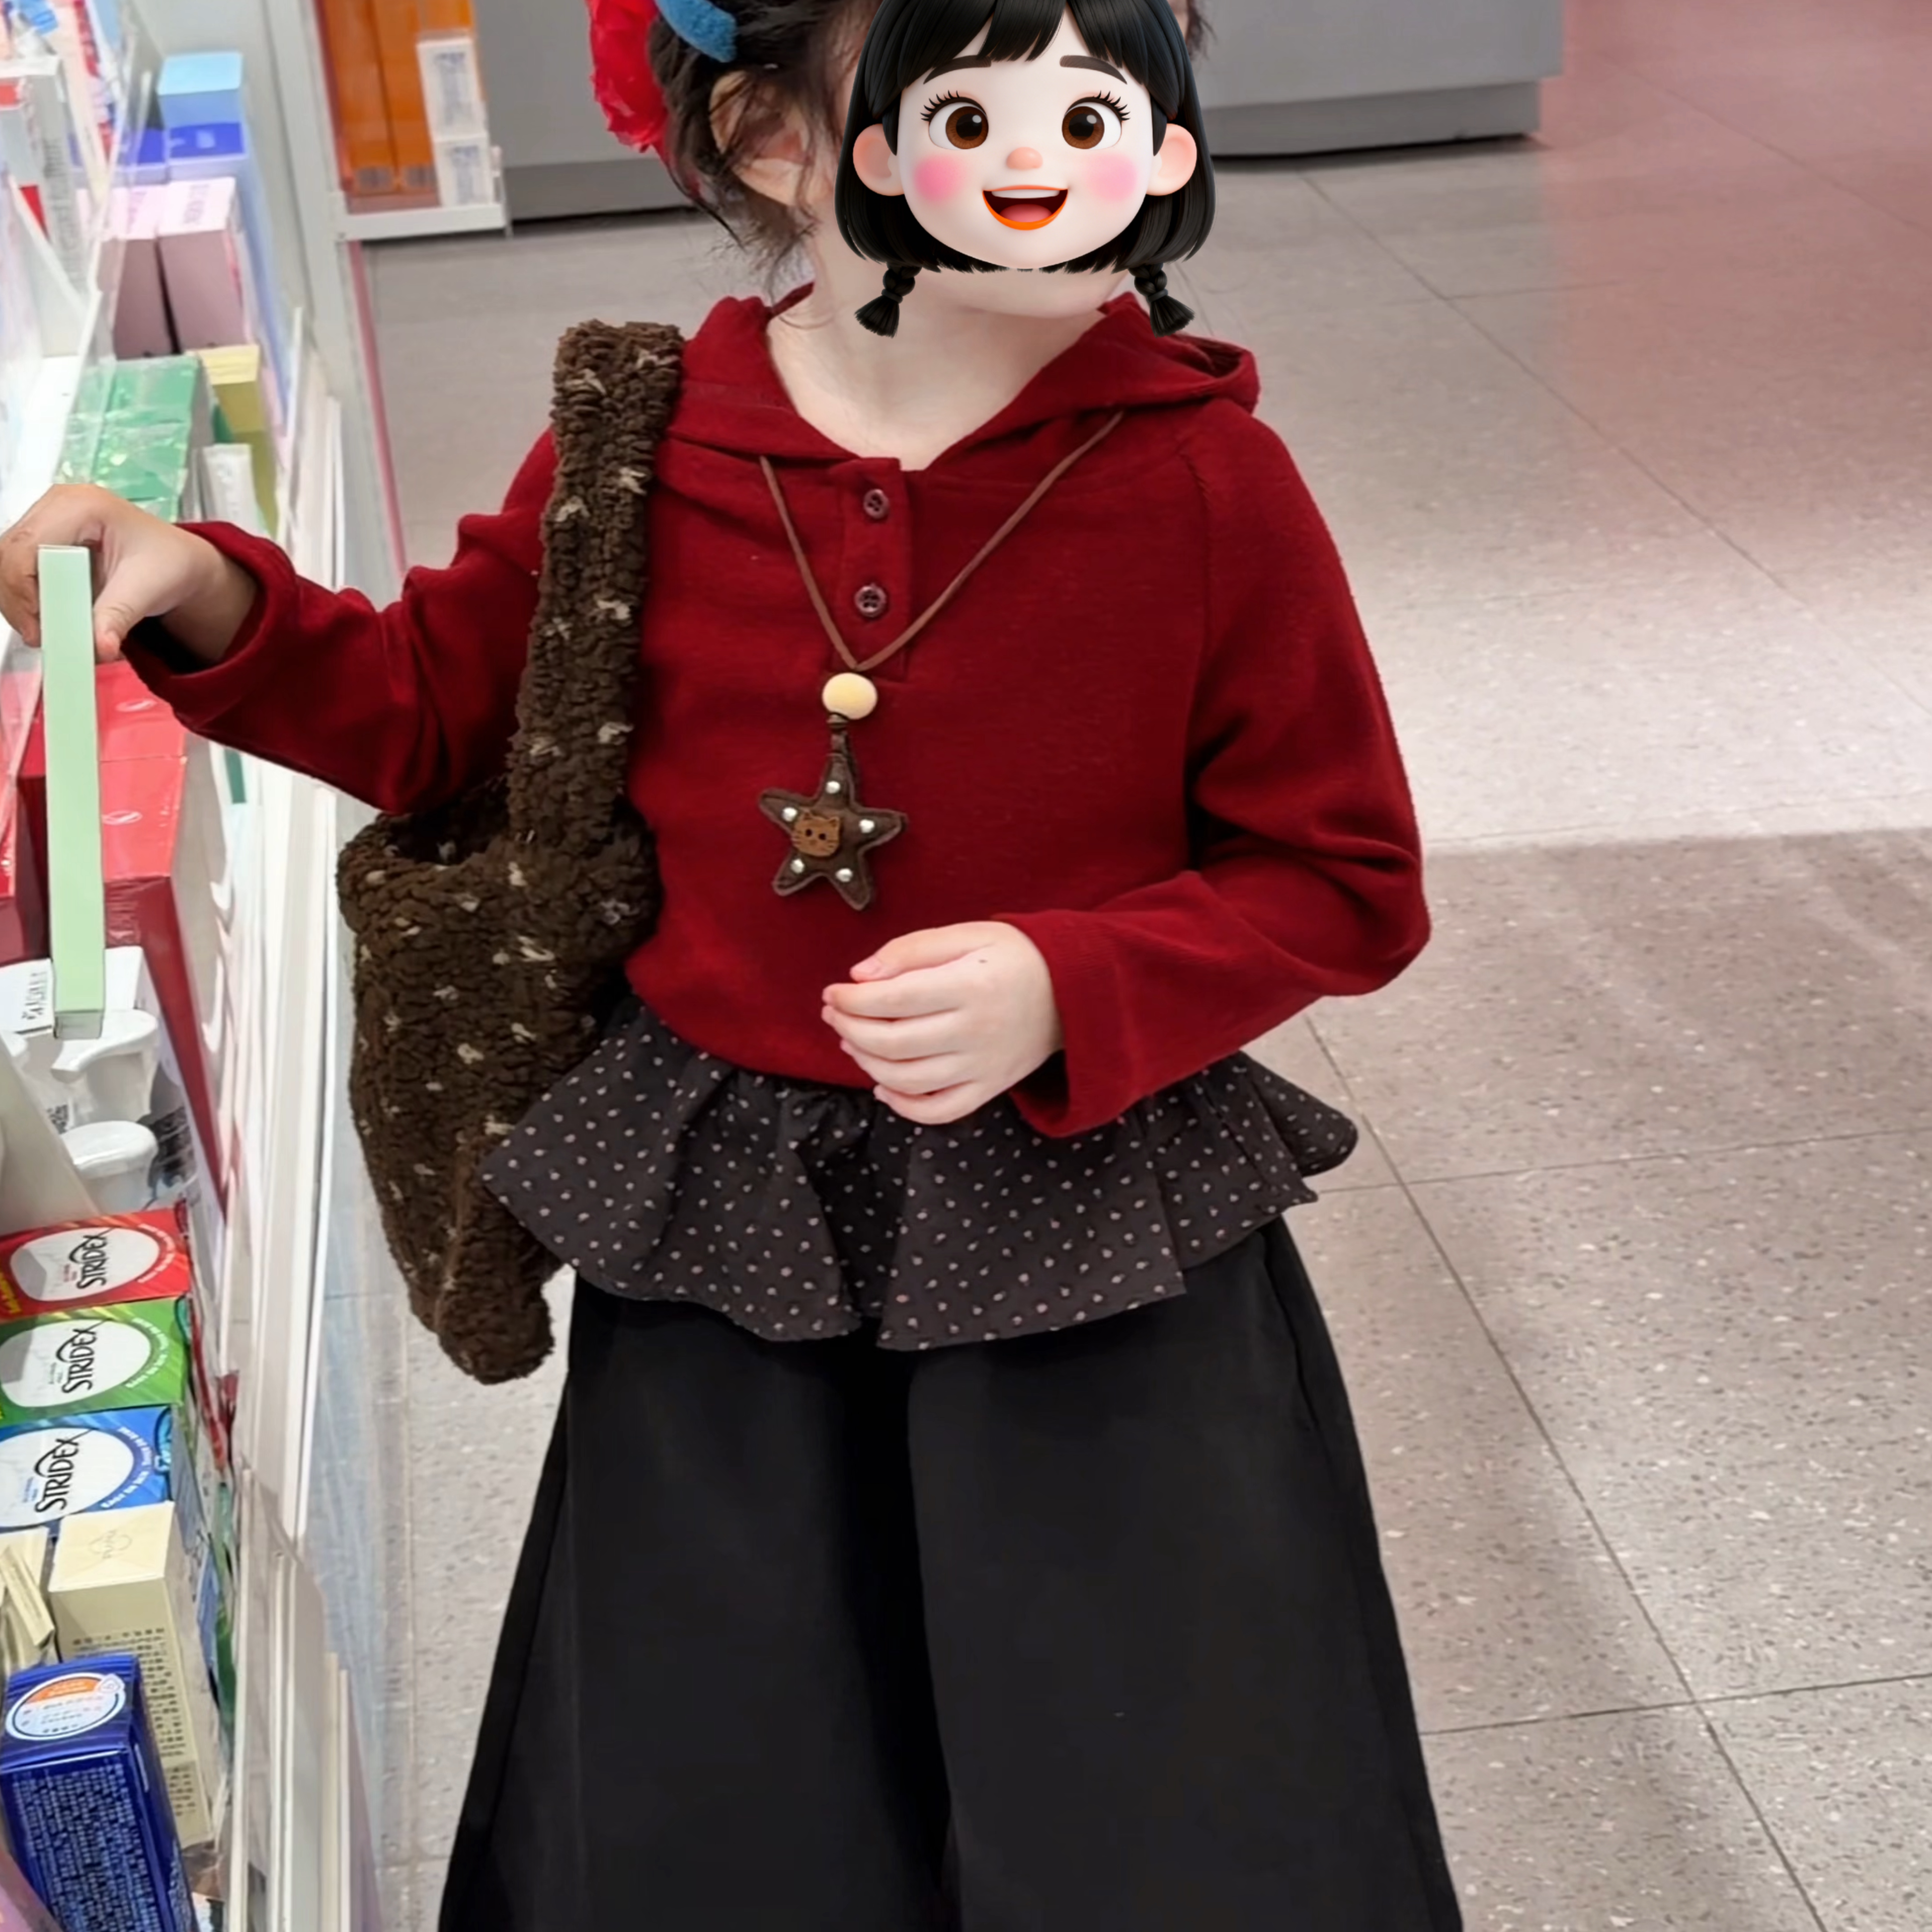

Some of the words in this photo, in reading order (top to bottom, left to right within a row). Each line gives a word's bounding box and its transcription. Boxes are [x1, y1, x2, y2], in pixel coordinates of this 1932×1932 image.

[69, 1229, 112, 1289] STRIDEX
[56, 1321, 102, 1393] STRIDEX
[34, 1431, 87, 1512] STRIDEX
